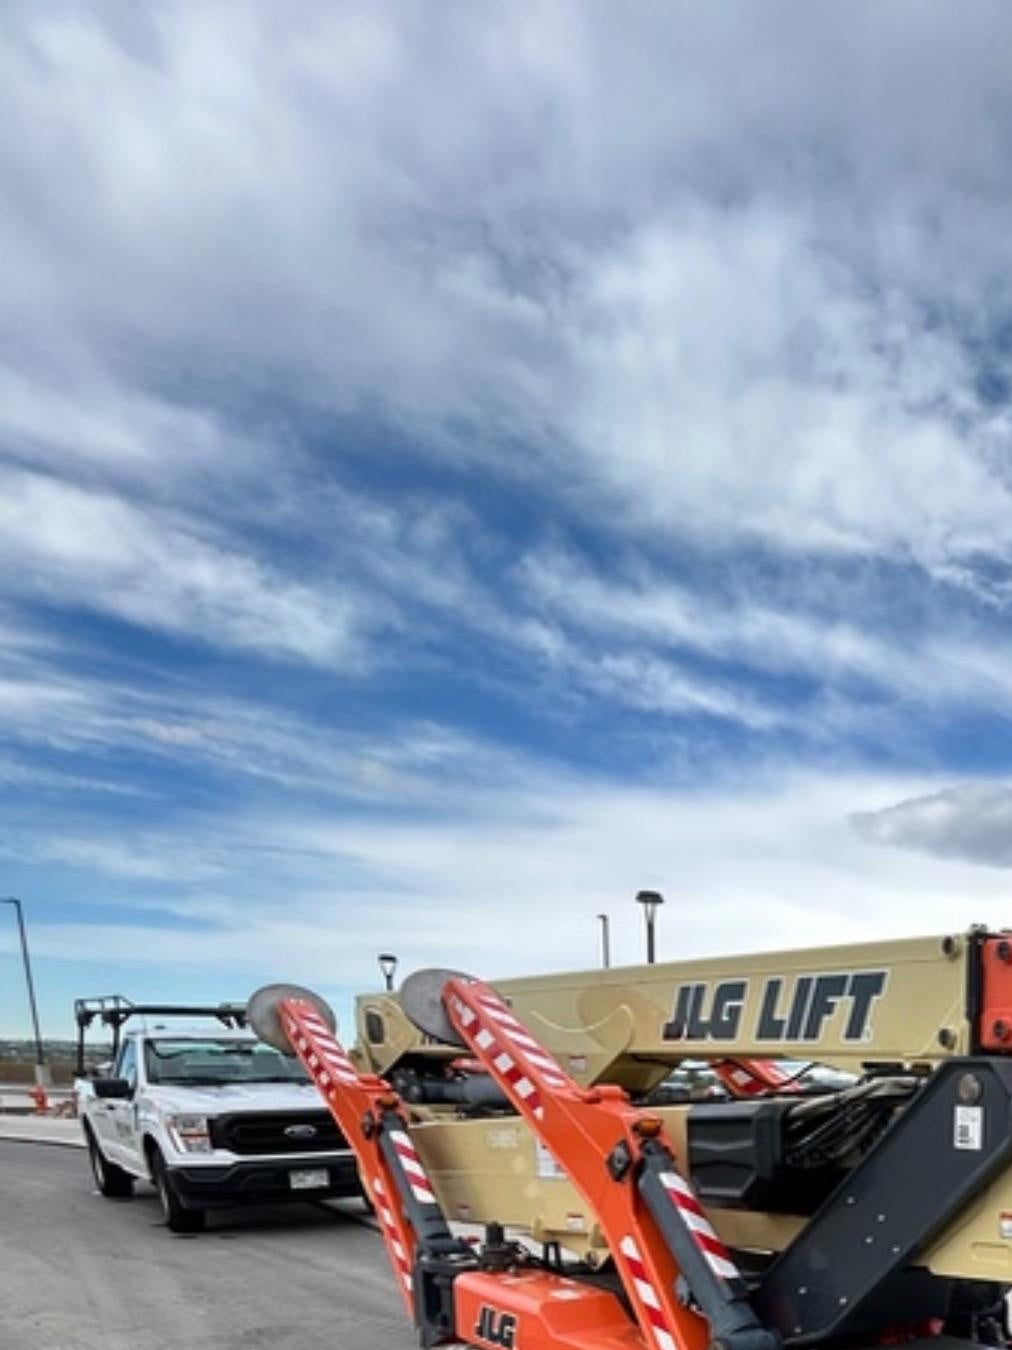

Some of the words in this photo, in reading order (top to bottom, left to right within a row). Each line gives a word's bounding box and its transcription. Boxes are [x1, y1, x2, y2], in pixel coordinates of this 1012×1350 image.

[662, 981, 748, 1041] JLG
[755, 971, 889, 1042] LIFT
[474, 1305, 518, 1350] JLG
